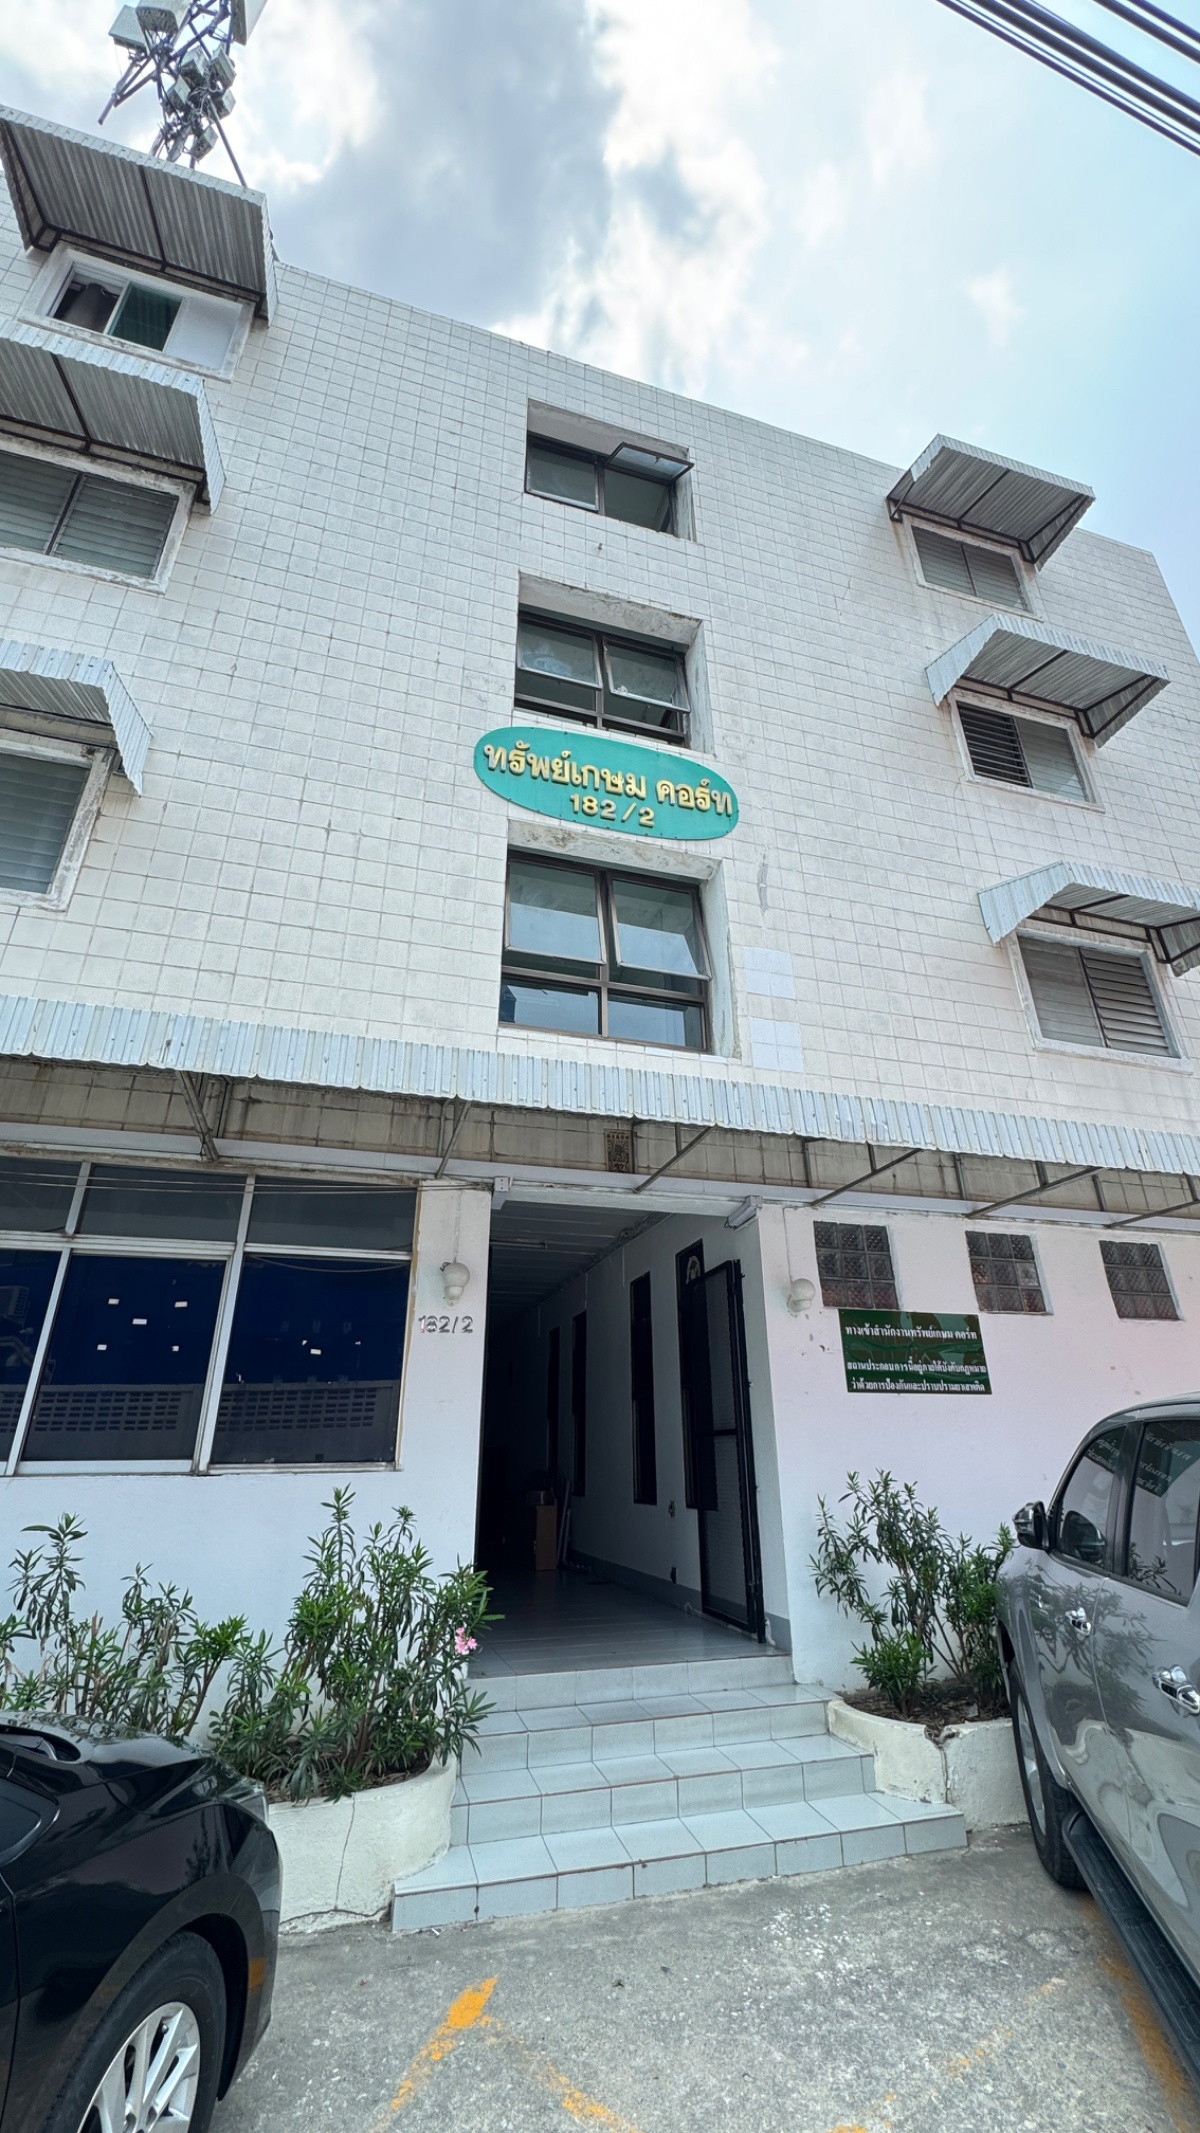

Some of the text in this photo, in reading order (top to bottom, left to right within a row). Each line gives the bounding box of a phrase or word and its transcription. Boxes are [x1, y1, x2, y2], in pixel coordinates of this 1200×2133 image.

[484, 740, 733, 817] ทรัพย์เกษม คอร์ท
[570, 793, 655, 827] 182/2
[418, 1315, 474, 1333] 182/2
